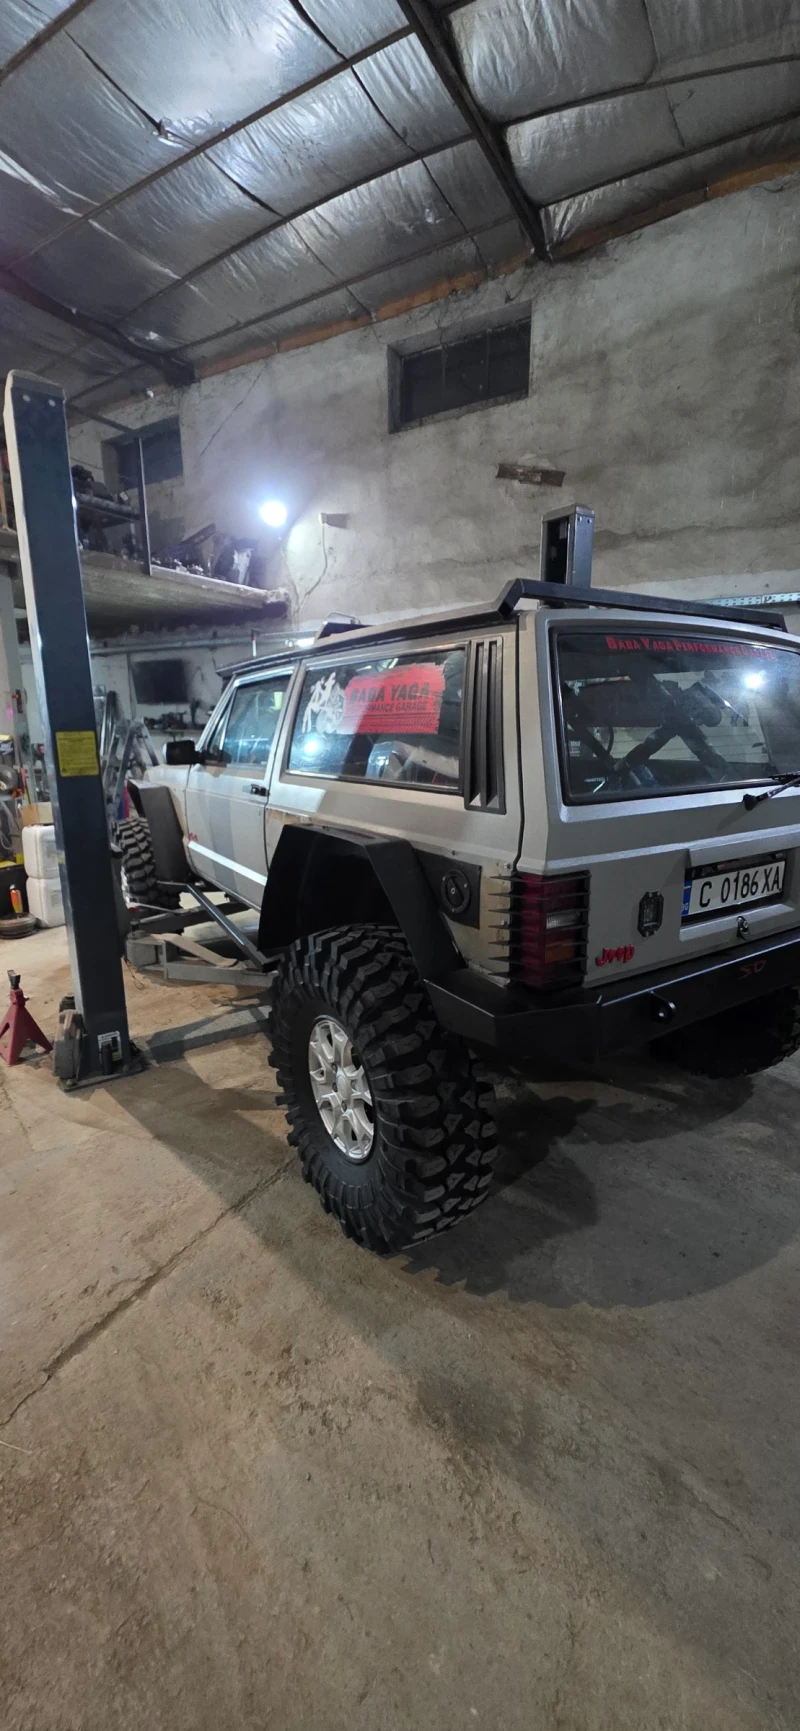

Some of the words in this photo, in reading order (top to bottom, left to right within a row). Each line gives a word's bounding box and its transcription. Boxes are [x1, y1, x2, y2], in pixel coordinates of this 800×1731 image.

[350, 686, 386, 702] BABA
[390, 682, 430, 701] YAGA
[395, 700, 427, 712] GARAGE
[699, 881, 712, 908] C
[720, 870, 758, 904] 0186
[760, 865, 782, 894] XA
